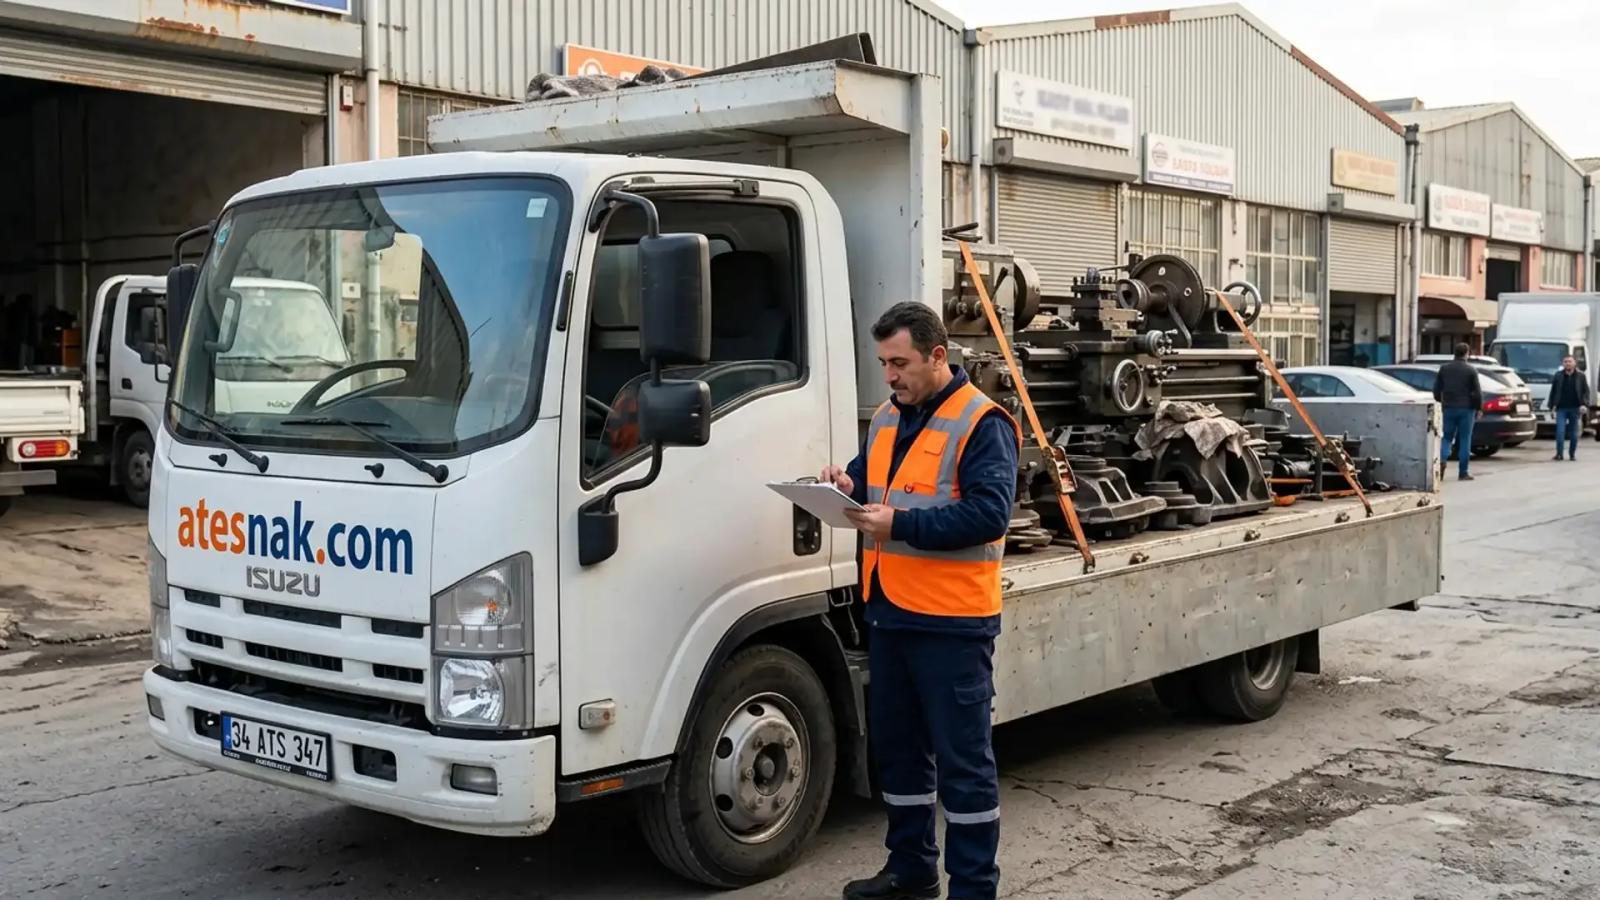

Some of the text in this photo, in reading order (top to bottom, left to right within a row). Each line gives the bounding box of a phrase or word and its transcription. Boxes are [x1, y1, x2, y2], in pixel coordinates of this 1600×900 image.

[178, 498, 413, 575] atesnak.com
[246, 565, 321, 597] ISUZU
[232, 721, 250, 750] 34
[257, 727, 286, 758] ATS
[293, 735, 323, 767] 347
